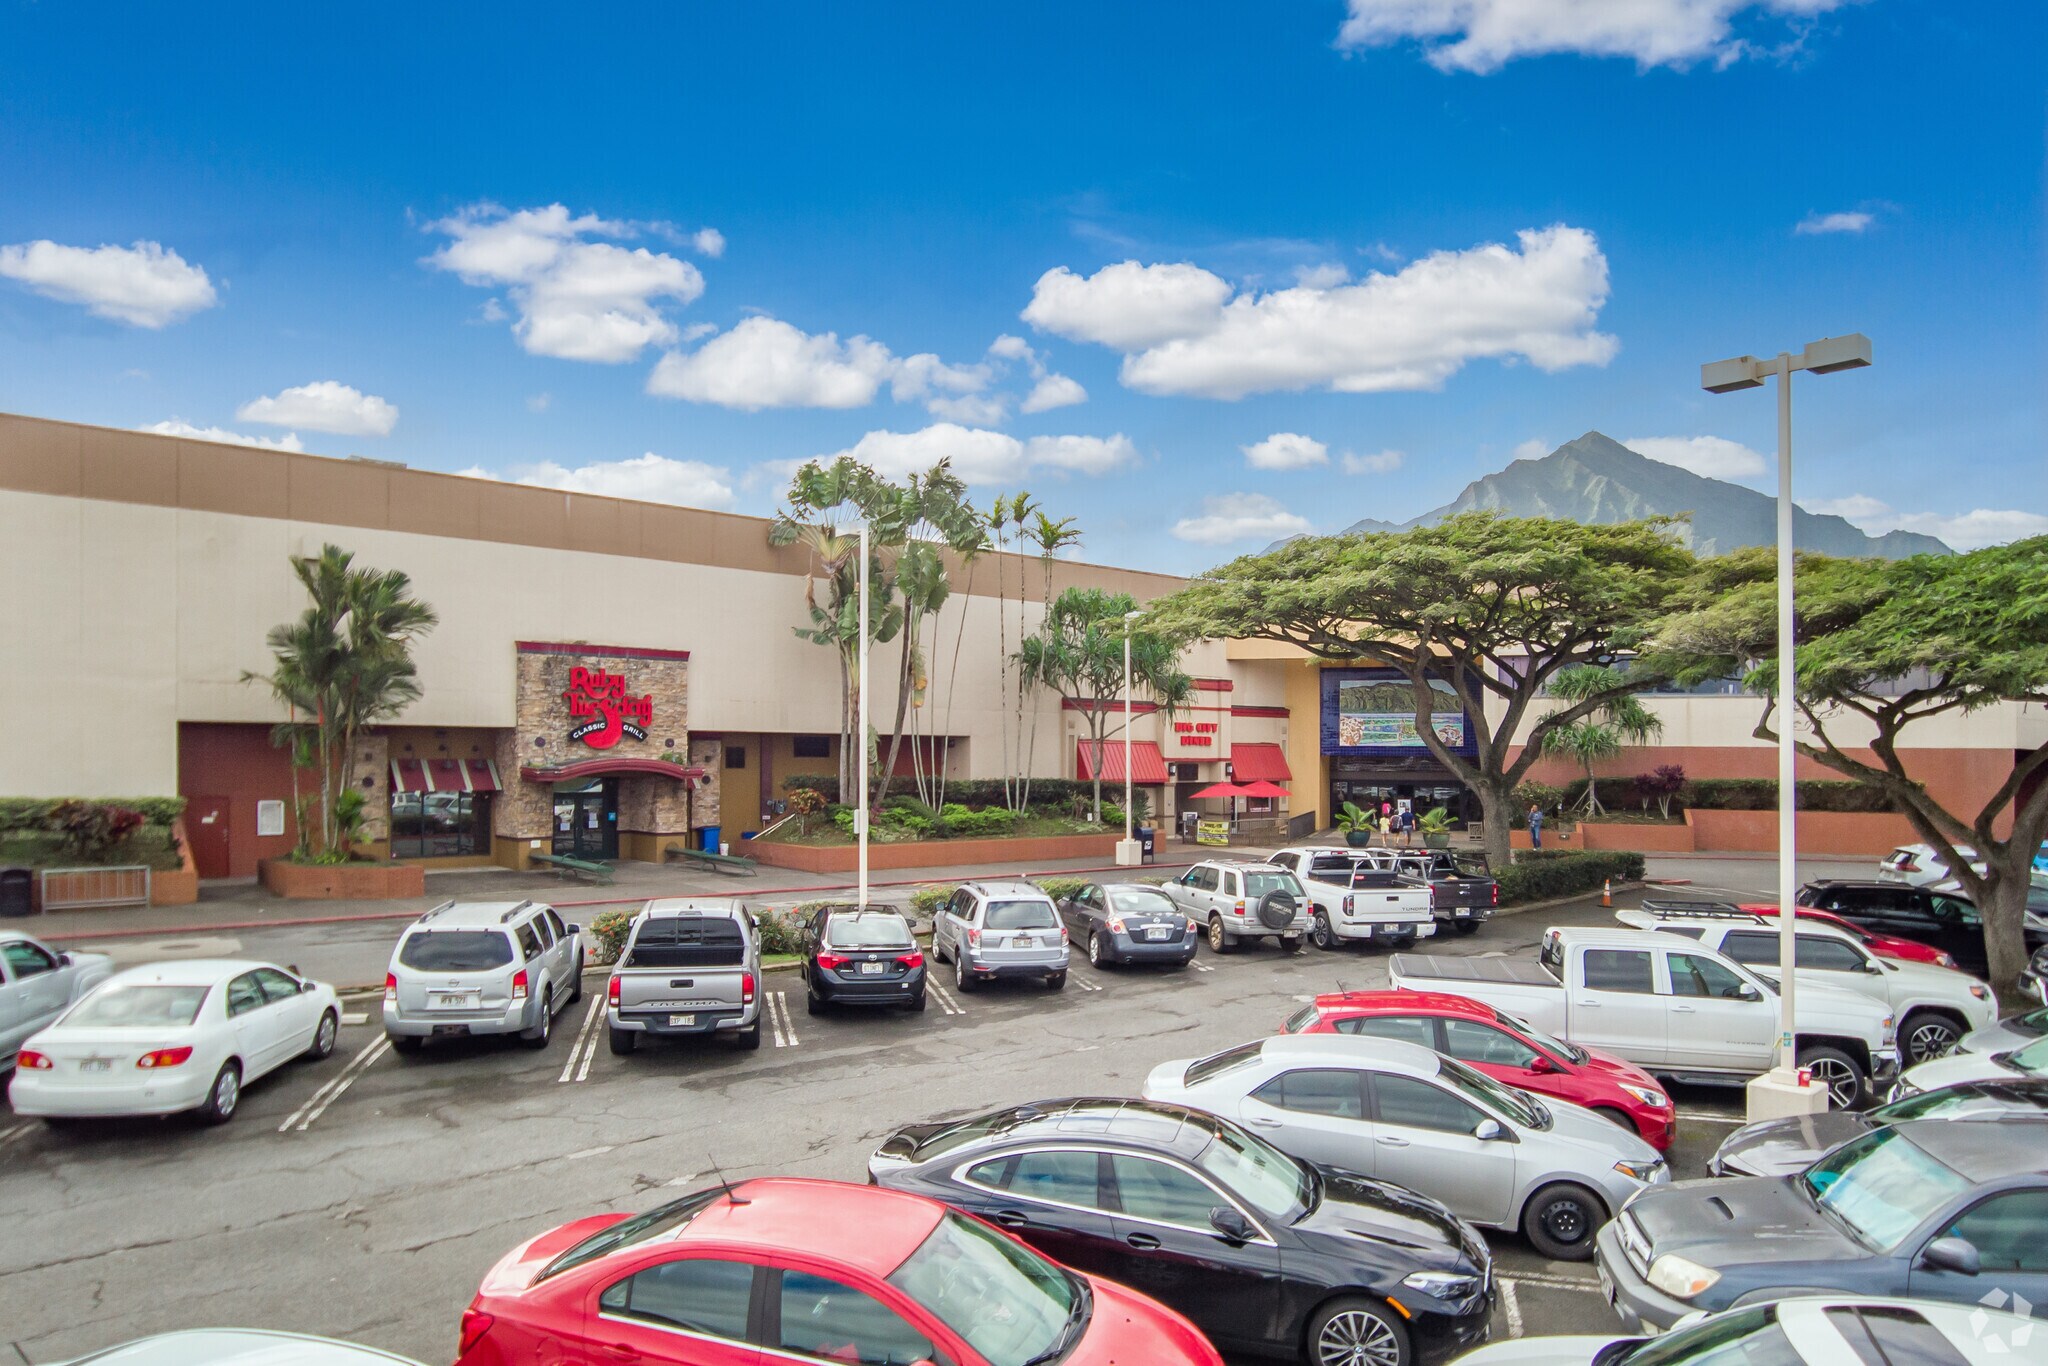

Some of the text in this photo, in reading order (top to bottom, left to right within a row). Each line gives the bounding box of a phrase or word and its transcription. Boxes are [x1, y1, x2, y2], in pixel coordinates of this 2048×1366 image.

[569, 666, 625, 699] Ruby
[562, 693, 653, 749] Tuesday
[1174, 722, 1218, 733] BIG CITY
[573, 722, 644, 739] CLASSIC GRILL
[1180, 736, 1212, 746] DINER
[648, 1000, 718, 1008] TACOMA
